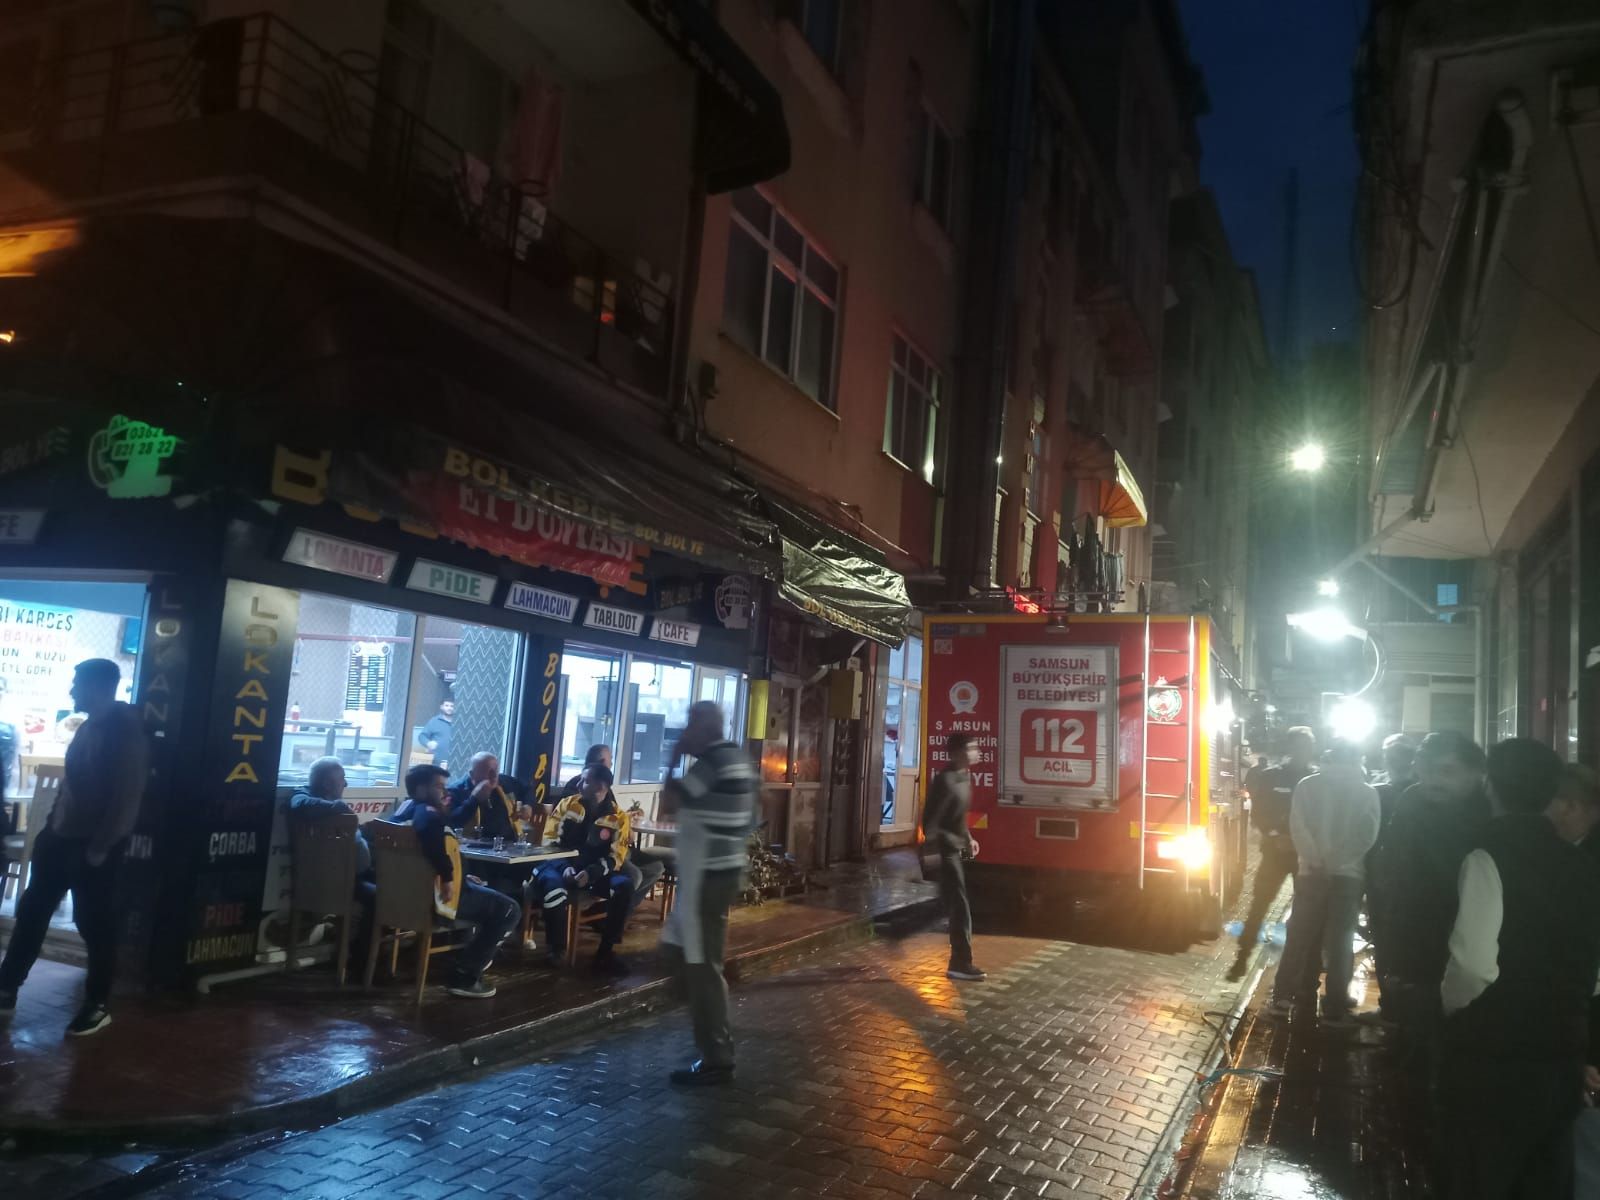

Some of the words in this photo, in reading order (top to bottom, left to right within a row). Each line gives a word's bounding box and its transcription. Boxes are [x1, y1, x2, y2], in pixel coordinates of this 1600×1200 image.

[512, 587, 571, 617] LAHMACUN
[593, 607, 638, 632] TABLDOT
[664, 622, 689, 641] CAFE
[1029, 658, 1090, 670] SAMSUN
[224, 597, 278, 784] LOKANTA
[1012, 672, 1107, 687] BÜYÜKŞEHİR
[540, 652, 559, 734] BOL
[1017, 688, 1101, 703] BELEDİYESİ
[935, 720, 991, 732] SMSUN
[1031, 717, 1085, 754] 112
[932, 751, 994, 763] BELESİ
[534, 753, 548, 804] BO
[208, 831, 258, 864] ÇORBA
